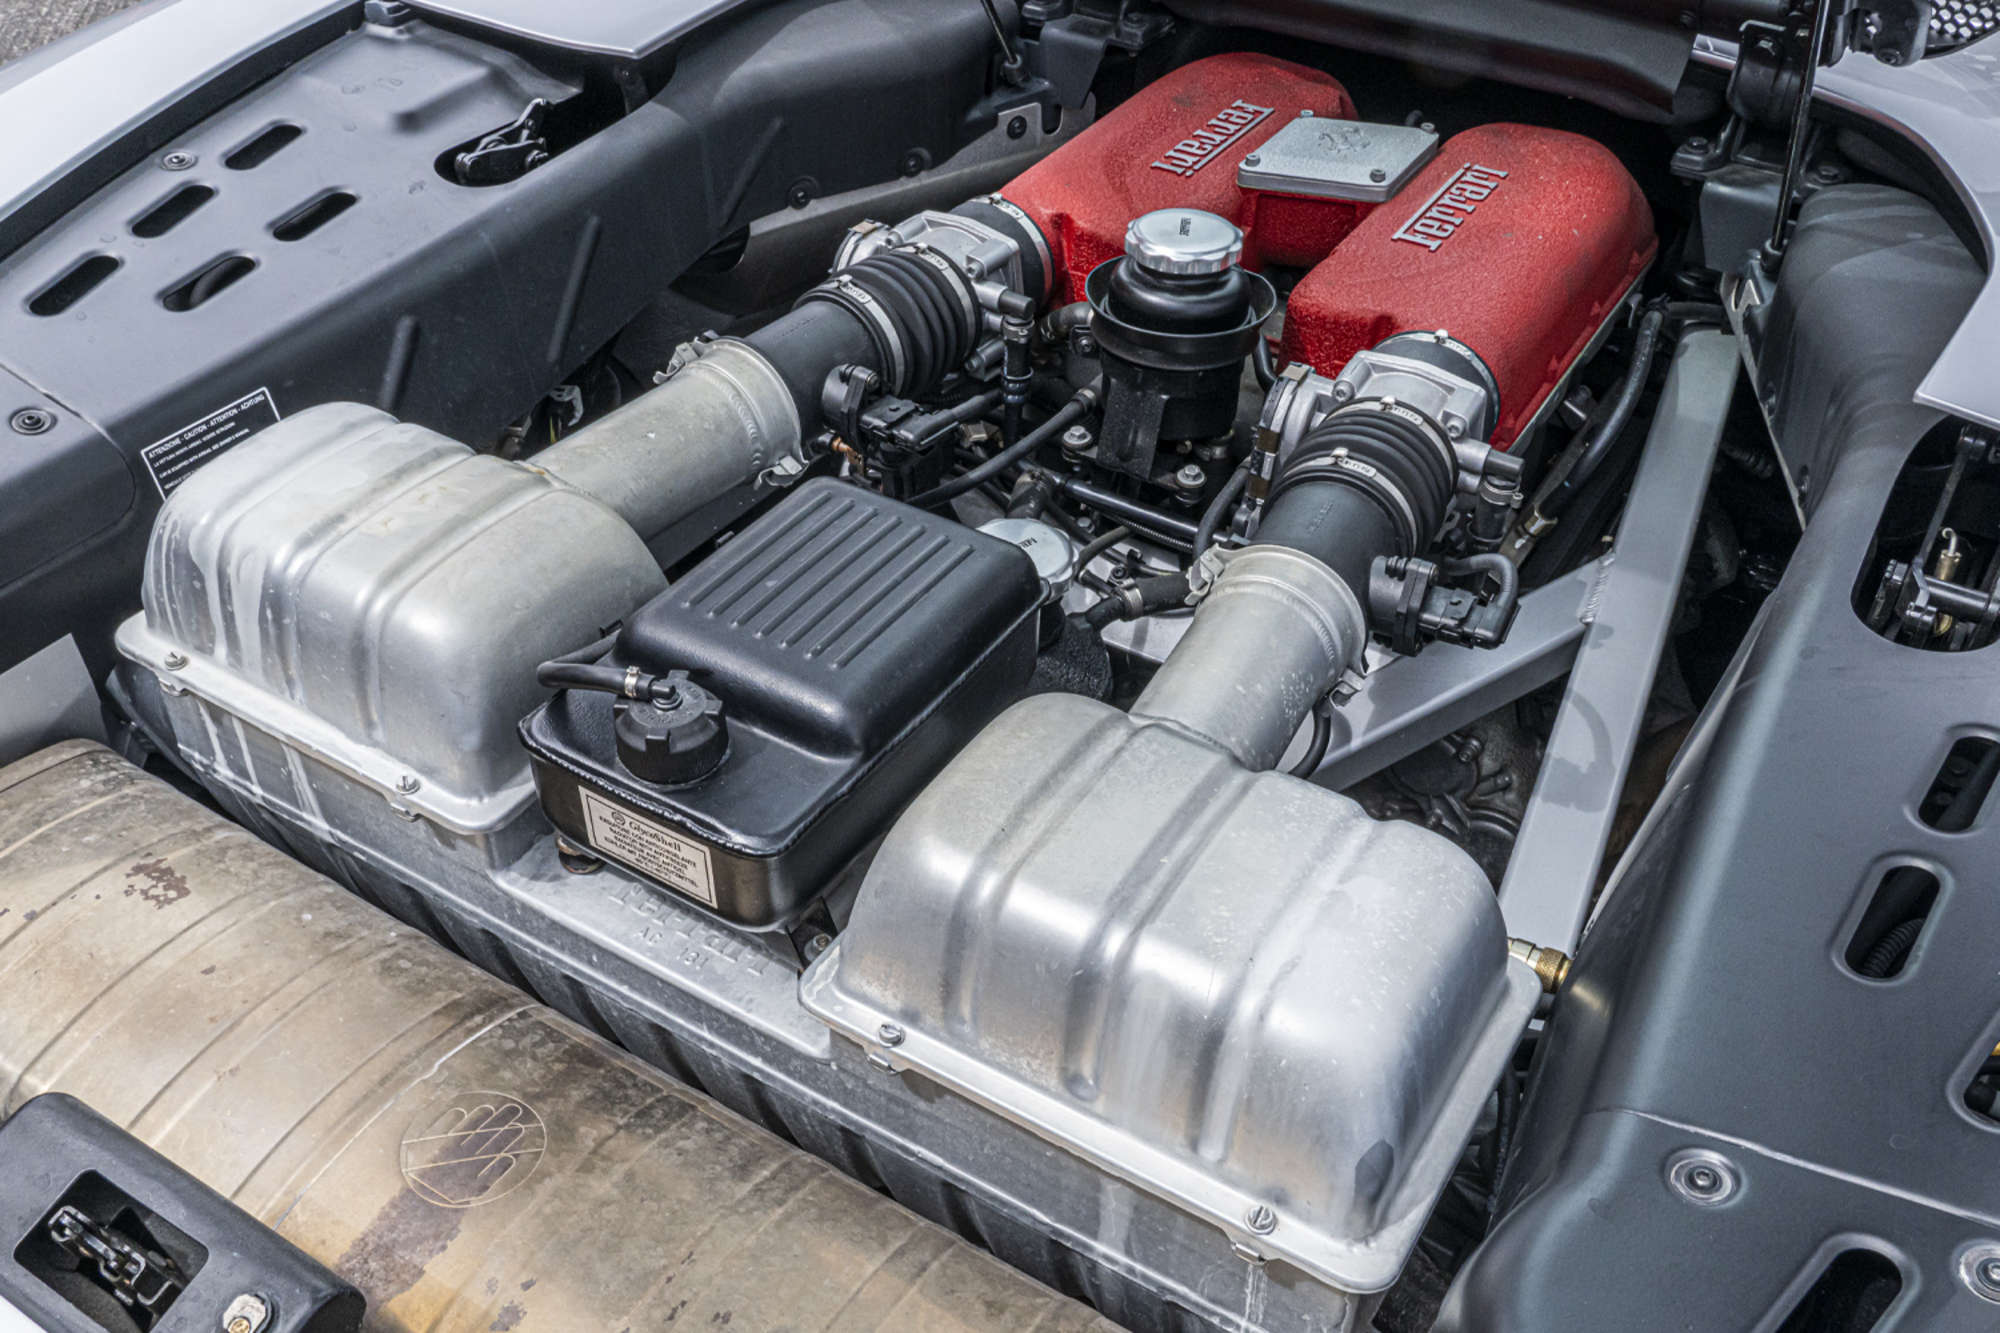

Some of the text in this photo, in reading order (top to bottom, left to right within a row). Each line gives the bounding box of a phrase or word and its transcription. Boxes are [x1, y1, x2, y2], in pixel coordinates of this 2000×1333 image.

[1151, 99, 1275, 177] Ferrari
[1391, 162, 1509, 252] Ferrari
[147, 437, 181, 459] ATTENZIONE
[183, 423, 207, 441] CAUTION
[209, 408, 238, 427] ATTENTION
[239, 393, 264, 411] ACHTUNG
[627, 818, 681, 854] GlycoShell
